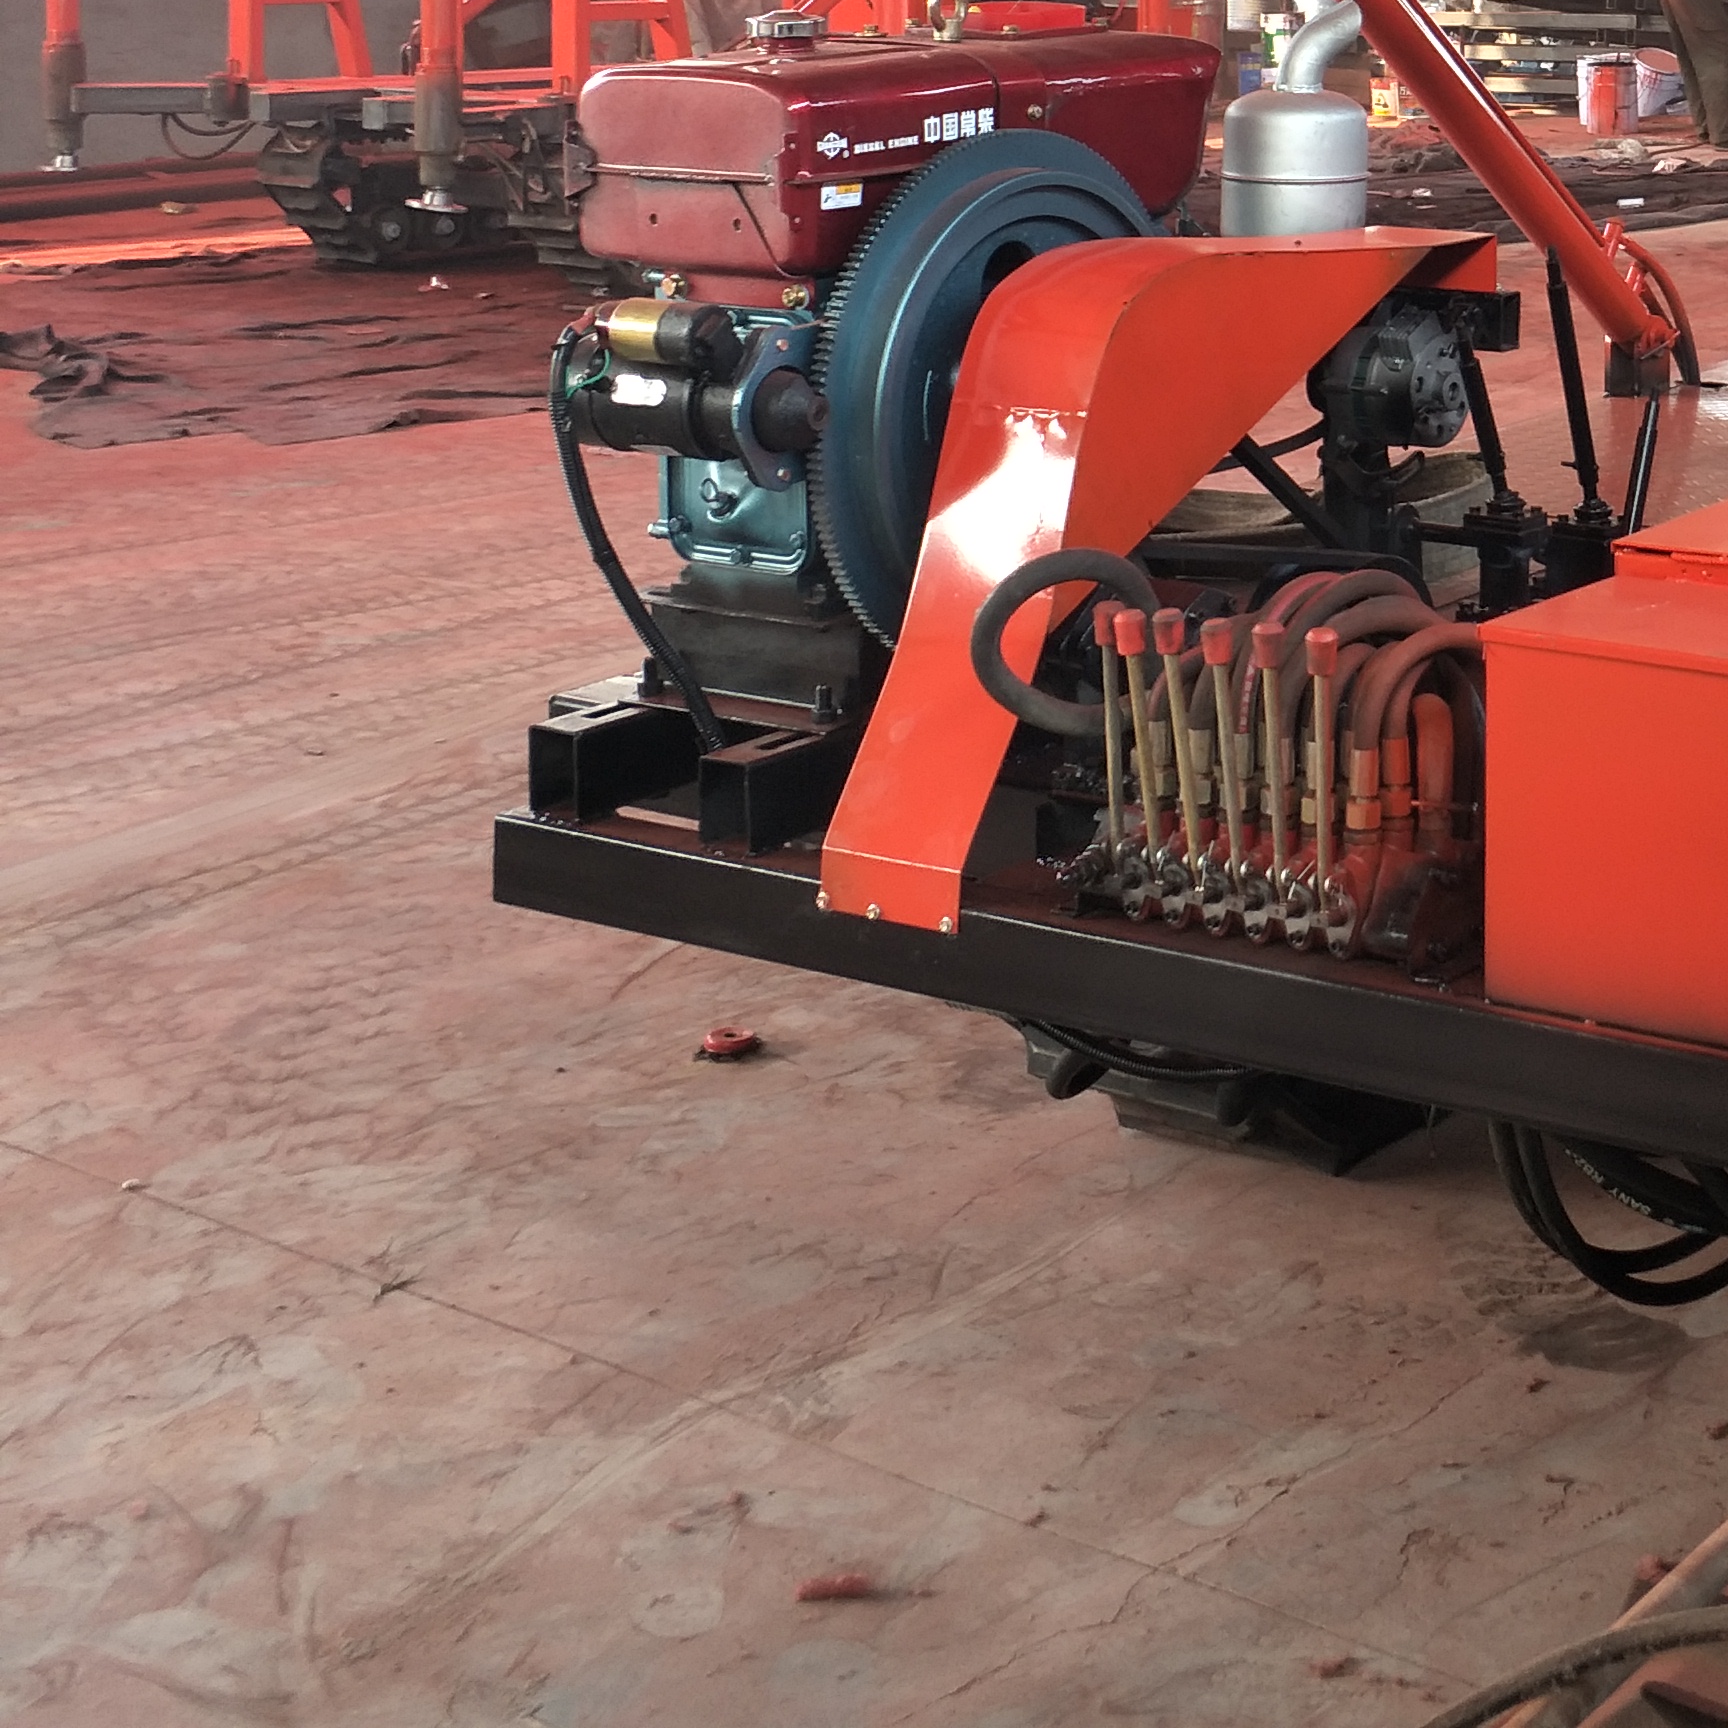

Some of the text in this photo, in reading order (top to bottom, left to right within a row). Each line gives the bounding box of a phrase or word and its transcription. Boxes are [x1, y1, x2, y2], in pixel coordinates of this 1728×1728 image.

[923, 107, 995, 144] 中国常柴
[853, 140, 886, 154] DIESEL
[888, 135, 920, 149] ENGINE
